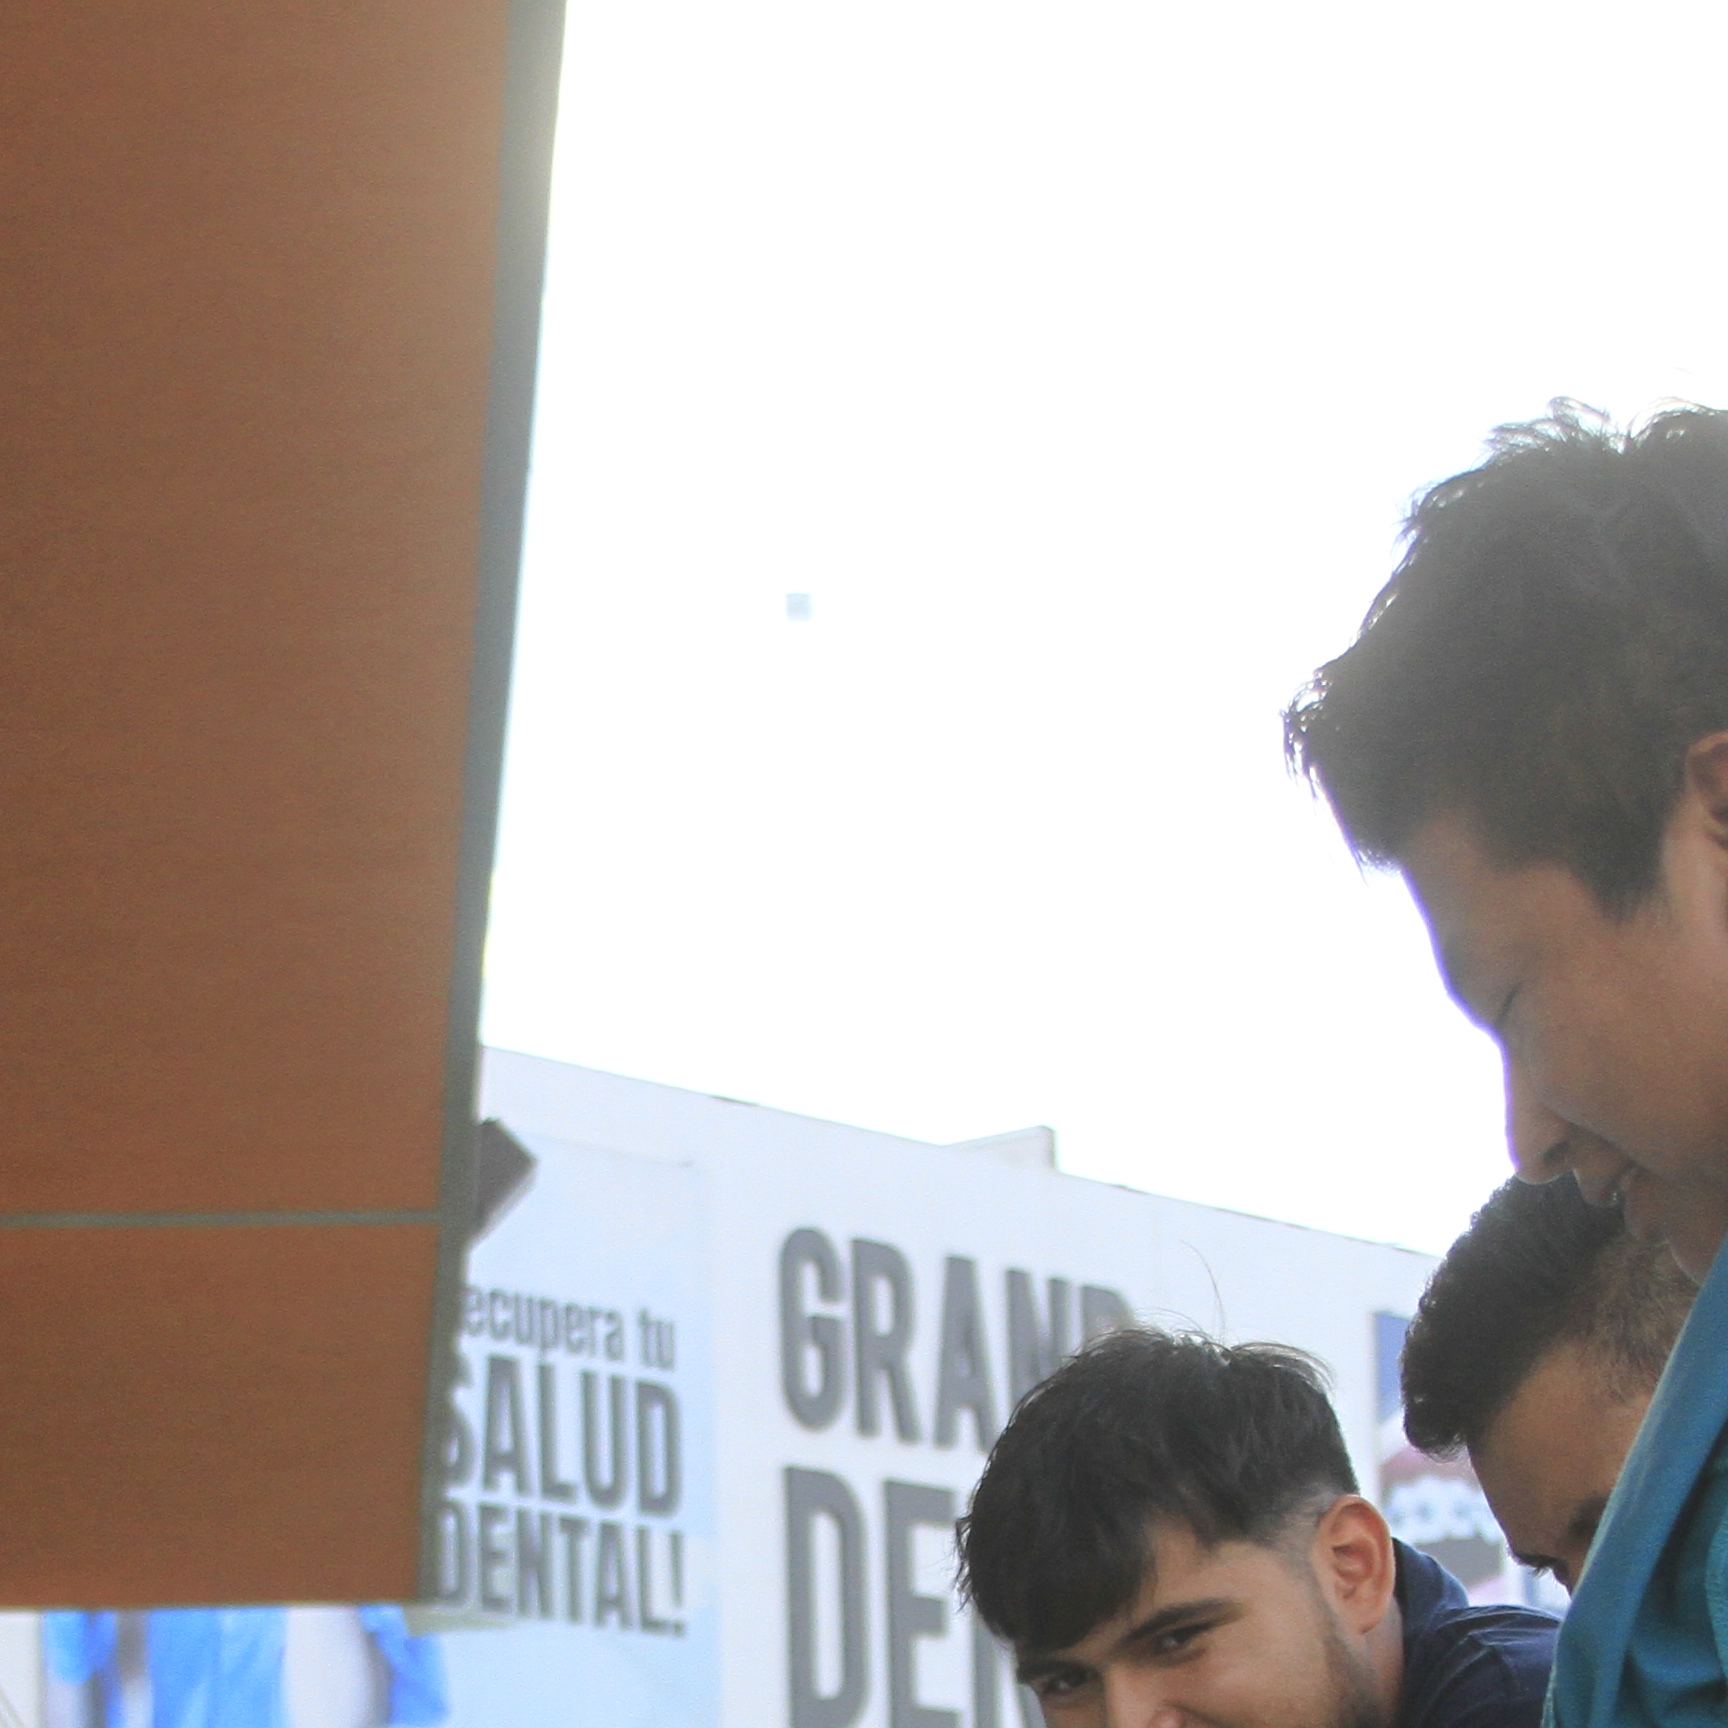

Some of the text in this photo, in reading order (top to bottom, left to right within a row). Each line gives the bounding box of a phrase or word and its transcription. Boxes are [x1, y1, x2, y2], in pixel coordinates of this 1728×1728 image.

[461, 1285, 676, 1371] ecupera tu
[434, 1500, 687, 1638] DENTAL!
